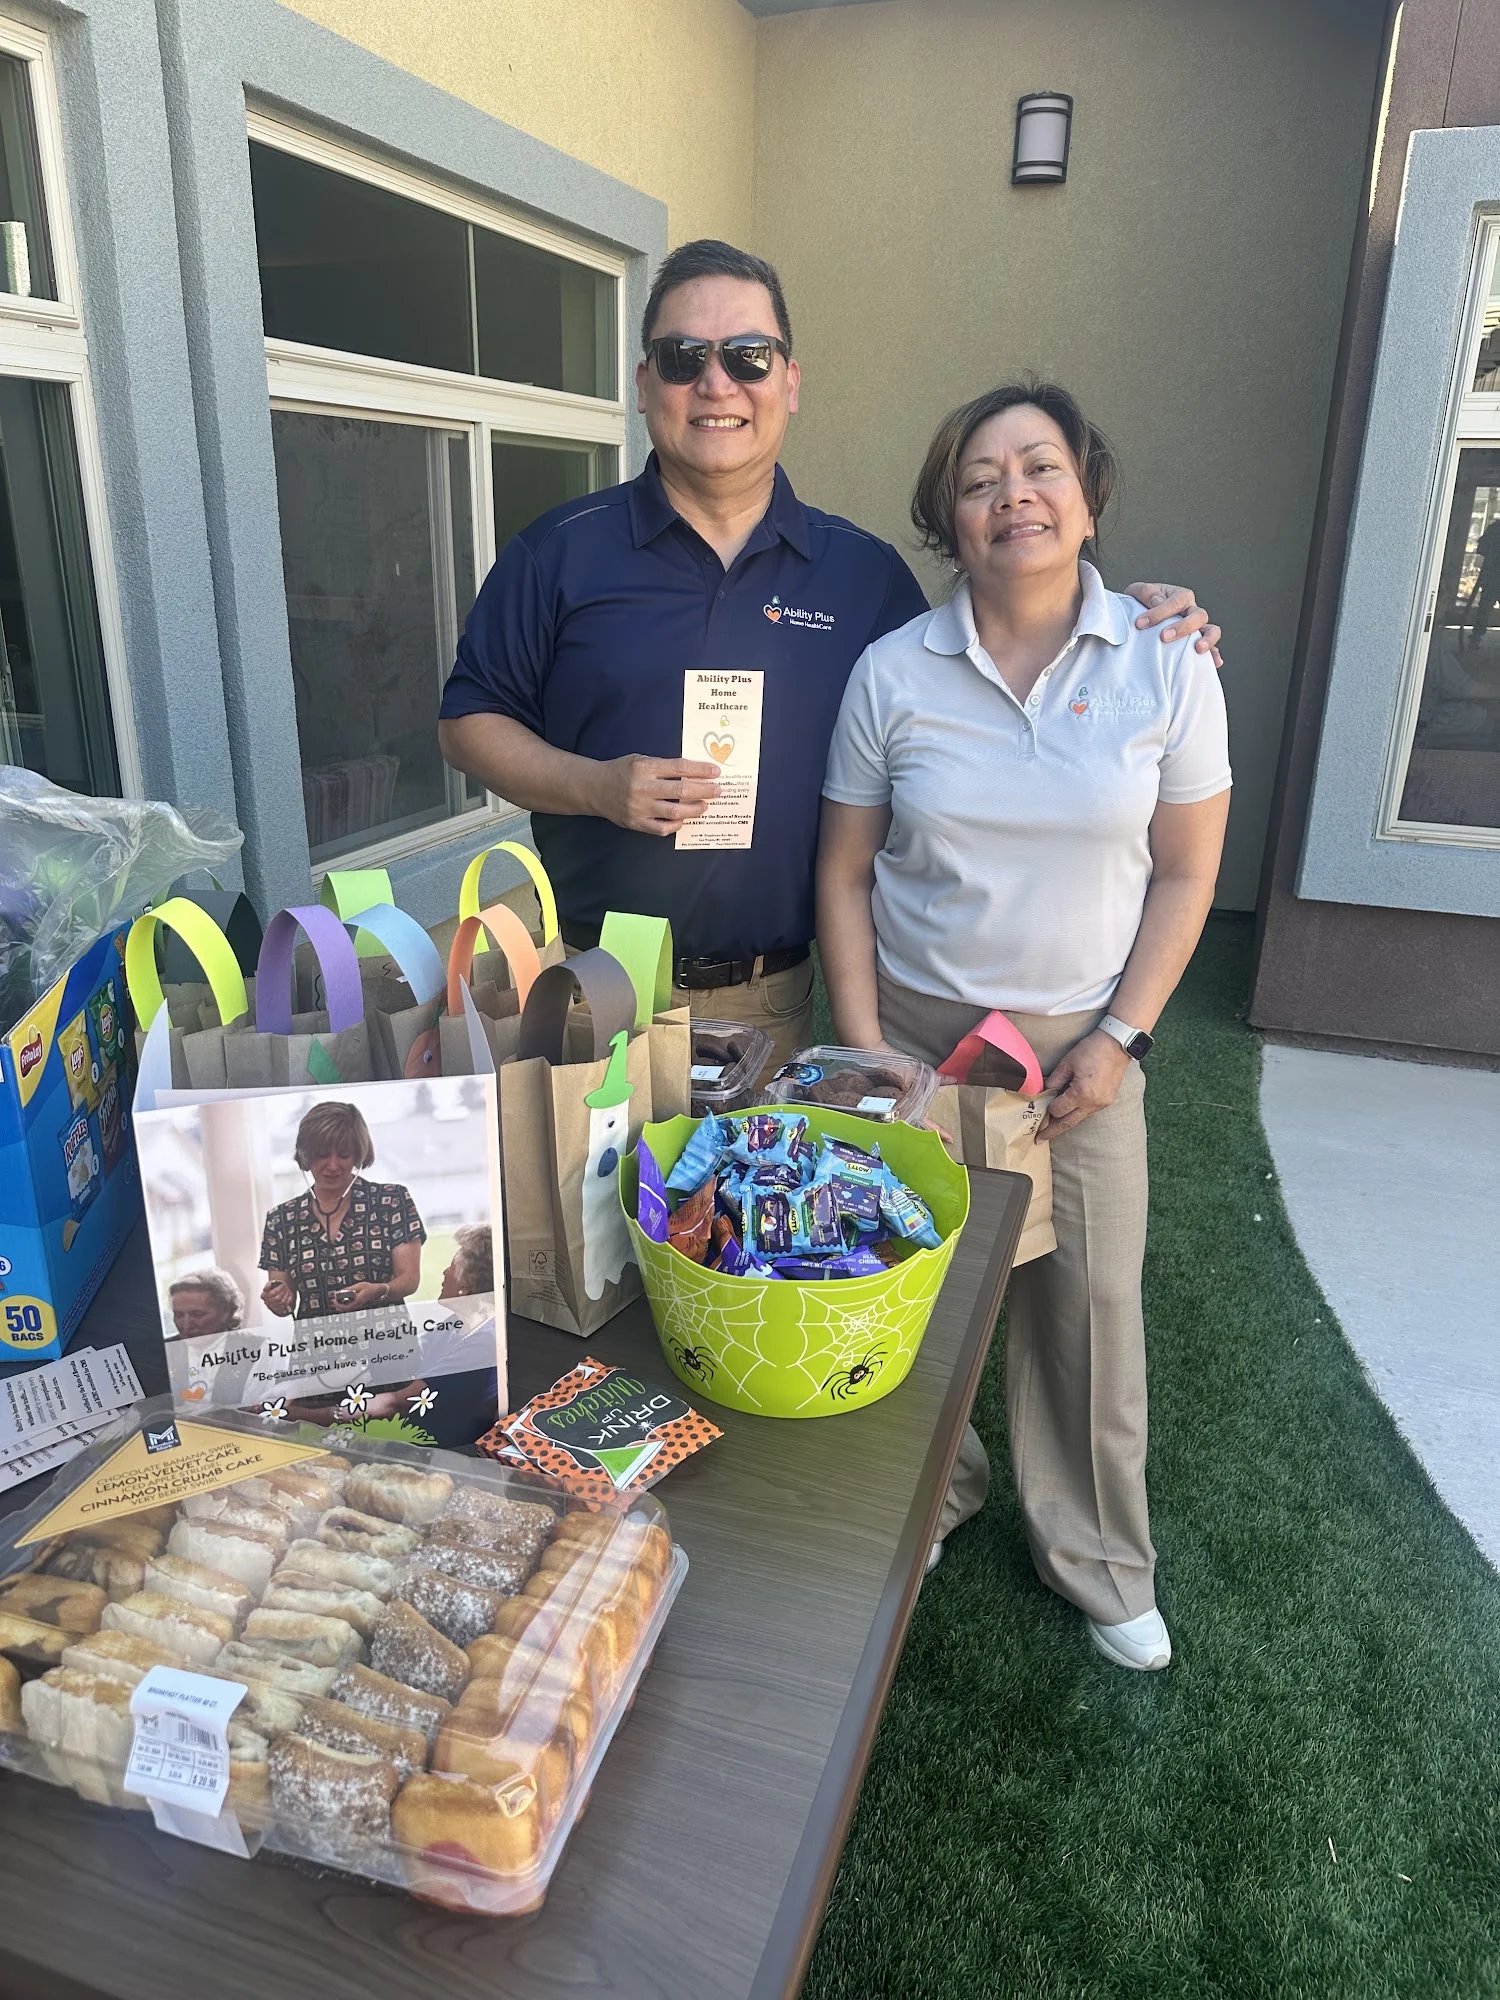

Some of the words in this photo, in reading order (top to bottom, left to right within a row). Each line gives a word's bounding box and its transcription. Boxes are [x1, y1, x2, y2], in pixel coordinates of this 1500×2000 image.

[783, 607, 812, 622] Ability
[814, 612, 835, 622] Plus
[697, 674, 730, 684] Ability
[710, 688, 737, 696] Home
[698, 702, 748, 710] Healthcare
[1028, 1101, 1035, 1110] 4
[64, 1118, 88, 1164] RUFFLES
[6, 1305, 42, 1332] 50
[12, 1332, 44, 1342] BAGS
[201, 1344, 261, 1368] Ability
[268, 1340, 308, 1358] Plus
[314, 1334, 358, 1350] Home
[364, 1324, 418, 1342] Health
[423, 1318, 464, 1332] Care
[310, 1362, 331, 1374] you
[334, 1358, 357, 1370] have
[548, 1376, 646, 1429] Witches
[588, 1394, 672, 1445] DRINK
[602, 1408, 623, 1424] UP
[149, 1439, 178, 1450] Member's
[96, 1474, 149, 1494] LEMON
[152, 1458, 202, 1477] VELVET
[205, 1446, 242, 1462] CAKE
[97, 1463, 161, 1485] CHOCOLATE
[164, 1451, 207, 1467] BANANA
[208, 1442, 238, 1456] SWIRL
[80, 1483, 168, 1512] CINNAMON
[172, 1467, 223, 1487] CRUMB
[225, 1454, 264, 1470] CAKE
[122, 1482, 146, 1494] ICED
[148, 1473, 178, 1487] APPLE
[180, 1462, 222, 1476] STRUDEL
[131, 1495, 156, 1505] VERY
[158, 1485, 188, 1498] BERRY
[190, 1476, 221, 1489] SWIRL
[148, 1686, 179, 1699] BREAKFAST
[179, 1693, 202, 1704] PLATTER
